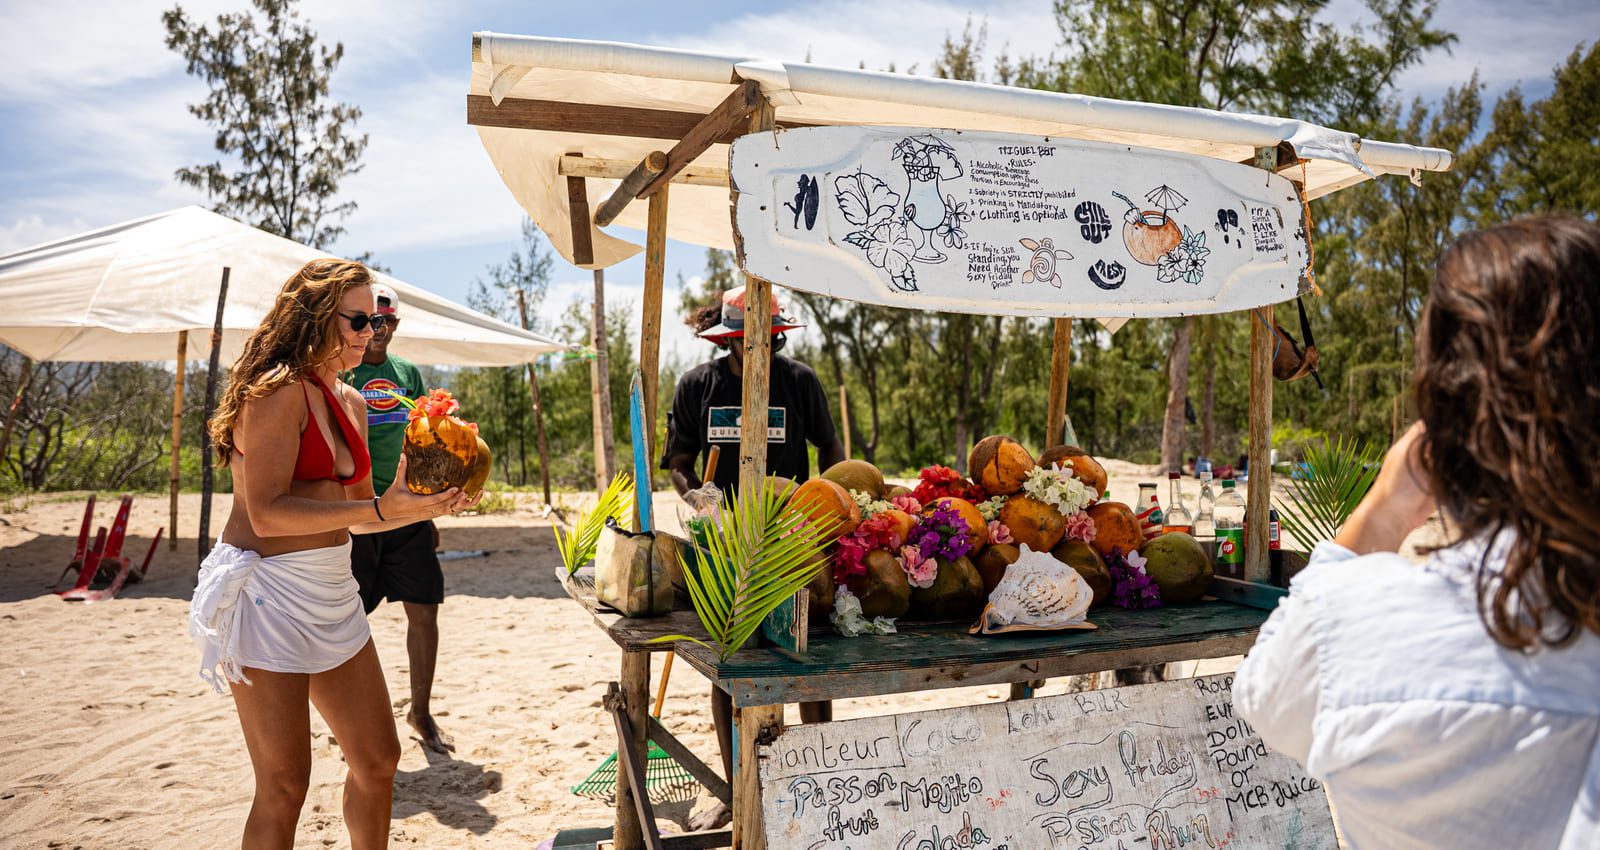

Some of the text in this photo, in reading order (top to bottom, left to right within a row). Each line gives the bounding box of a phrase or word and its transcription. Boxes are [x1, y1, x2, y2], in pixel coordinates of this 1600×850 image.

[979, 198, 1007, 211] Drinking
[1017, 199, 1059, 211] Mandatory
[1008, 189, 1044, 198] STRICTLY
[1022, 211, 1030, 220] is
[1032, 208, 1068, 223] Optional
[1074, 201, 1111, 224] CHILL
[1080, 222, 1112, 244] OUT
[1252, 223, 1273, 232] MAN
[968, 264, 991, 273] Need
[1194, 677, 1233, 696] Roup
[1206, 703, 1233, 722] Eur
[1207, 719, 1256, 748] Doll
[772, 732, 890, 770] lanteur
[1210, 737, 1267, 773] Pound
[1030, 758, 1114, 815] Sexy
[1231, 764, 1254, 788] or
[900, 773, 983, 813] Mojito
[1225, 776, 1320, 822] MCB Juice
[823, 804, 880, 841] fruit
[1041, 813, 1136, 850] Pssion
[1144, 810, 1216, 850] Rhum
